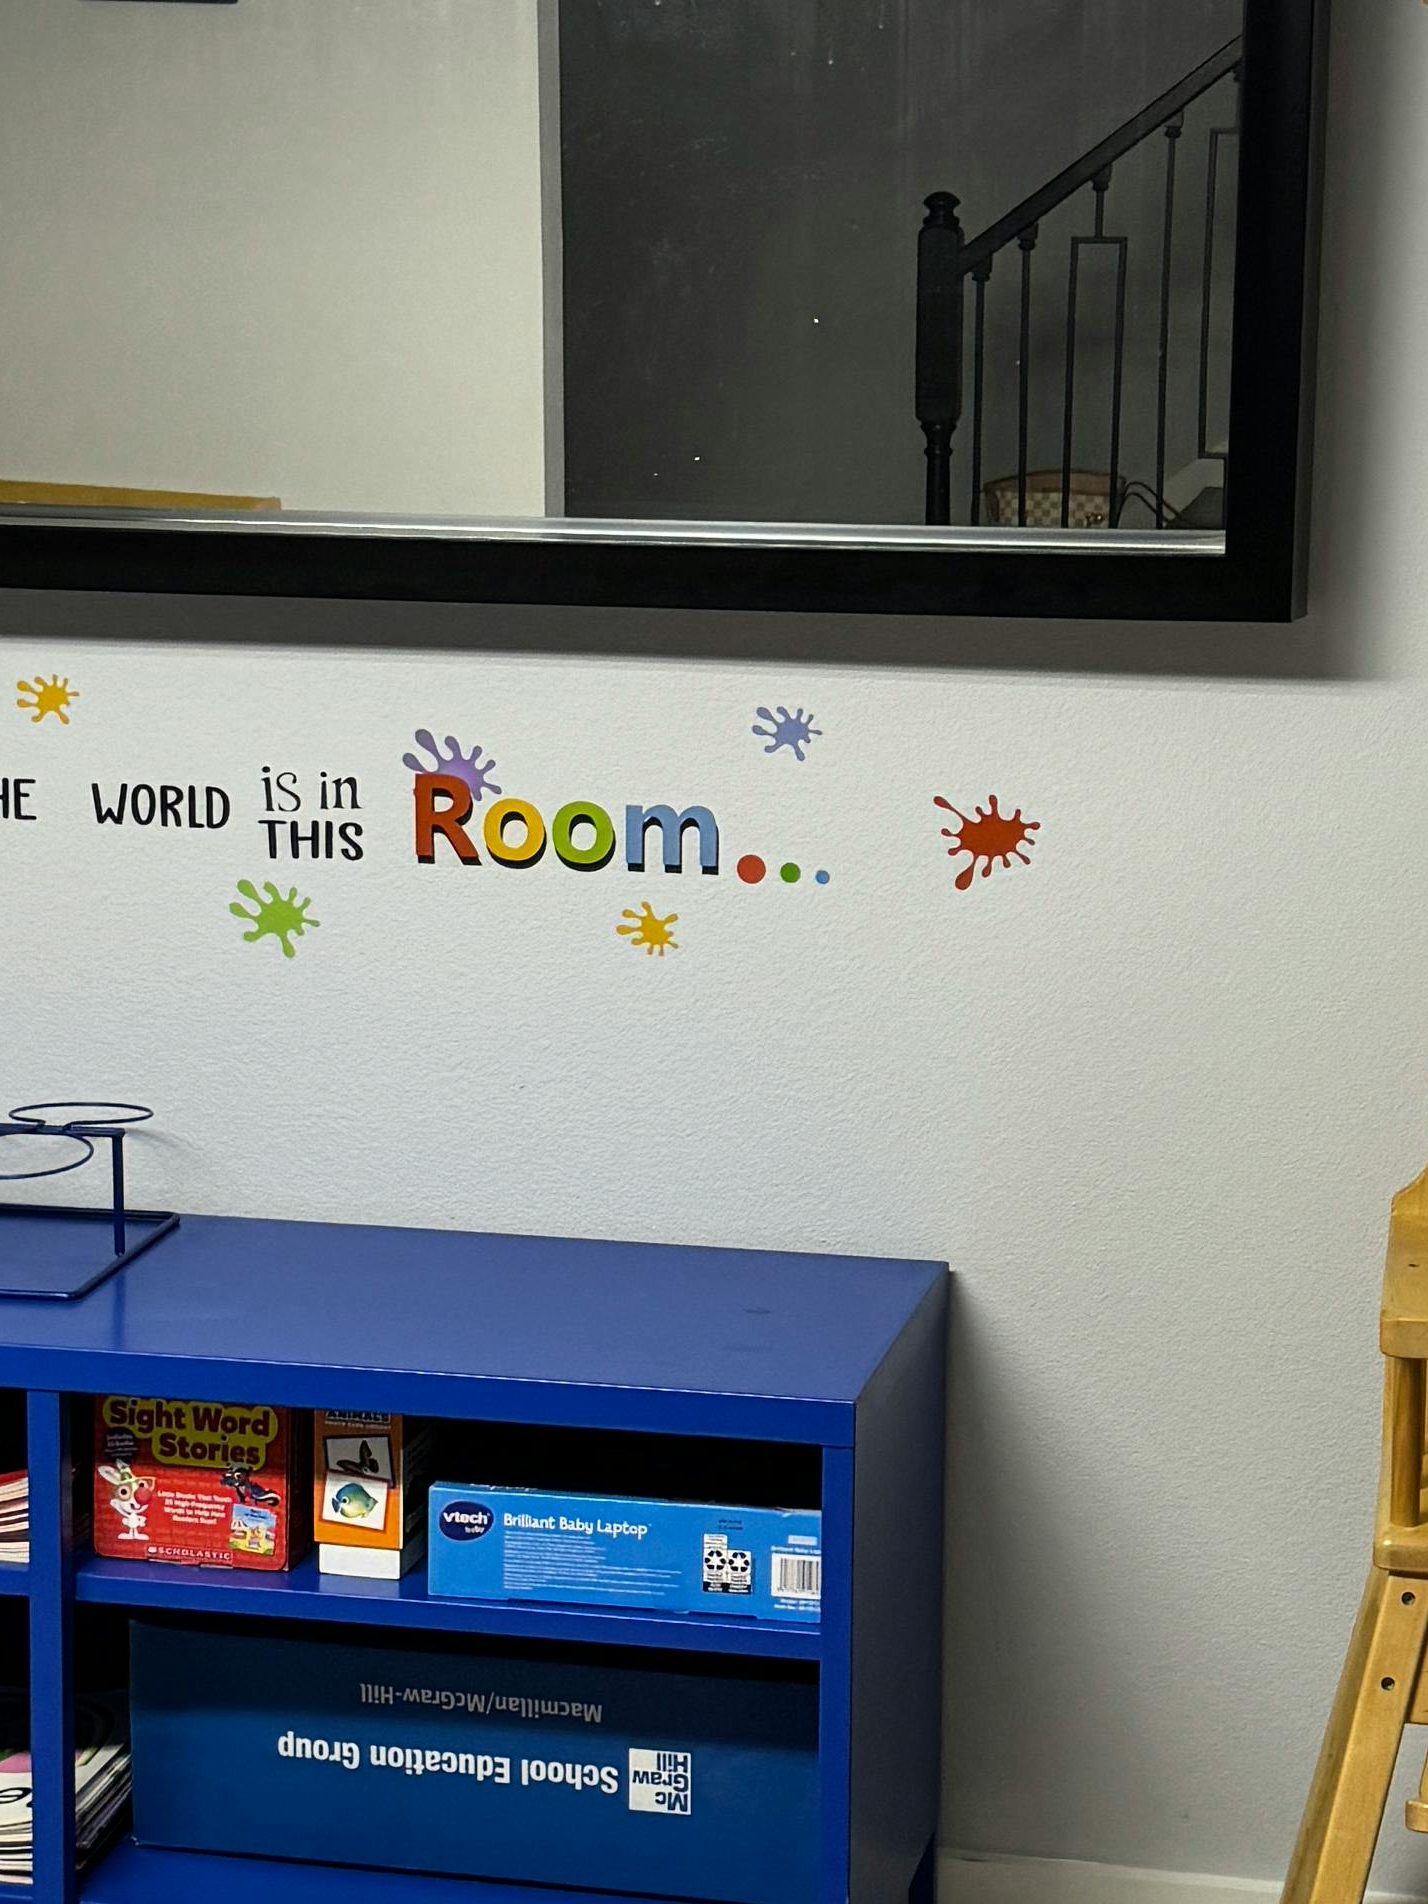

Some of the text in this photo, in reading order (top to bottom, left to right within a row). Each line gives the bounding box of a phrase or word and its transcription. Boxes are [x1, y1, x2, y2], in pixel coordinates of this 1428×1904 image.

[91, 782, 231, 829] WORLD
[260, 765, 362, 812] is in
[257, 819, 364, 861] THIS
[109, 1399, 271, 1438] Sight Word
[159, 1432, 261, 1466] Stories
[443, 1511, 489, 1525] vtech
[503, 1512, 648, 1540] Brilliant Baby Laptop
[157, 1546, 231, 1561] SCHOLASTIC
[360, 1683, 603, 1724] Macmillan/McGraw-Hill
[277, 1731, 619, 1794] School Education Group
[656, 1752, 689, 1775] Hill
[632, 1769, 690, 1793] Graw
[654, 1790, 689, 1812] Mc
